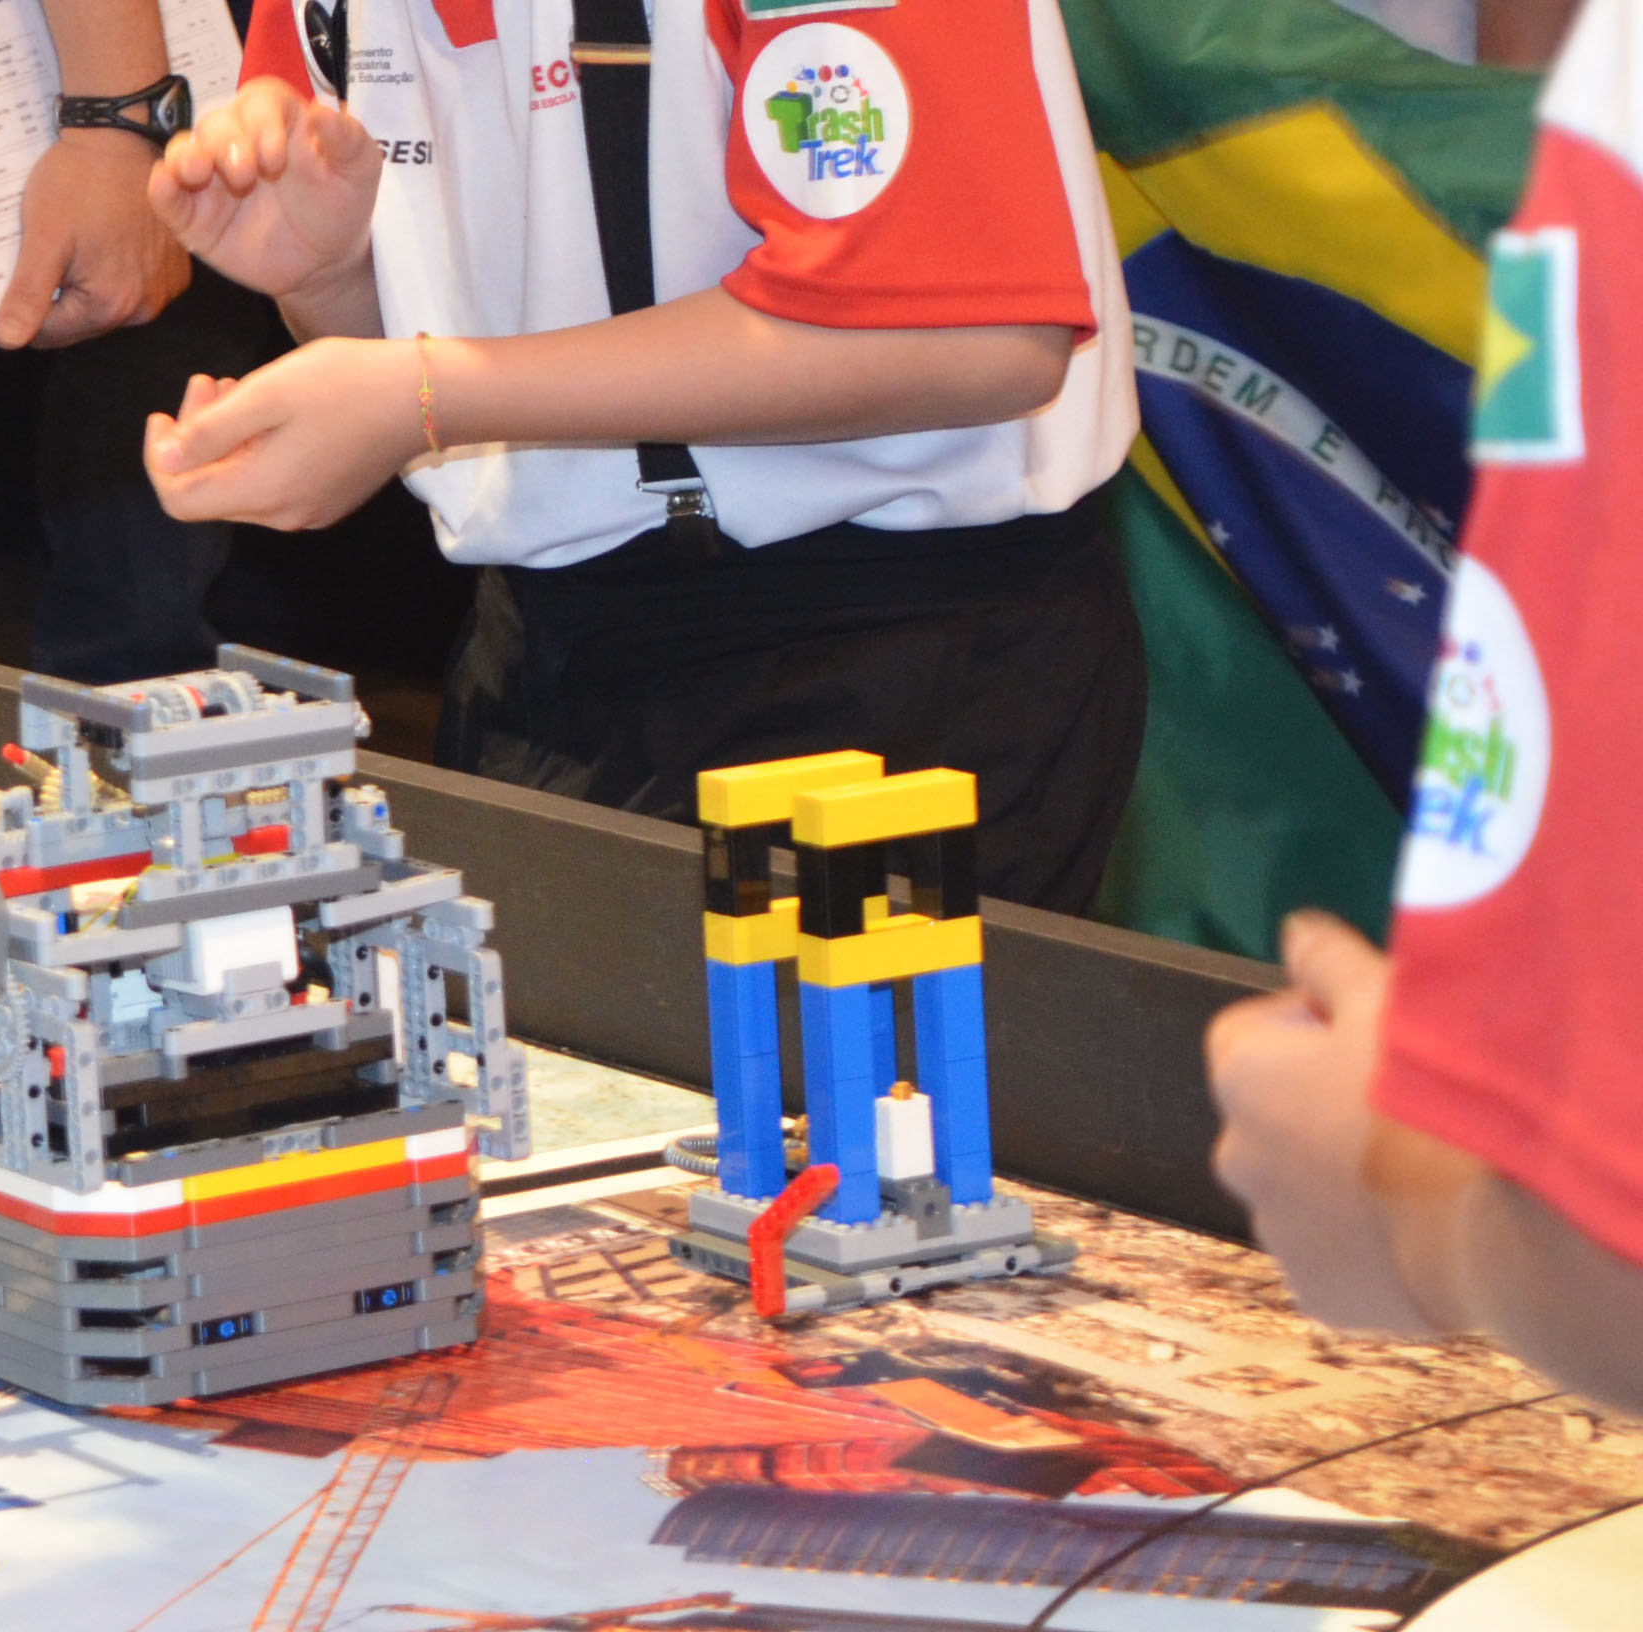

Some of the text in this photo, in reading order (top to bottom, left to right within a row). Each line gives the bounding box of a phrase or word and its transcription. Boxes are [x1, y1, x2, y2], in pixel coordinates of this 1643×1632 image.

[764, 90, 885, 154] Trash
[798, 133, 881, 183] Trek
[1309, 417, 1345, 464] E
